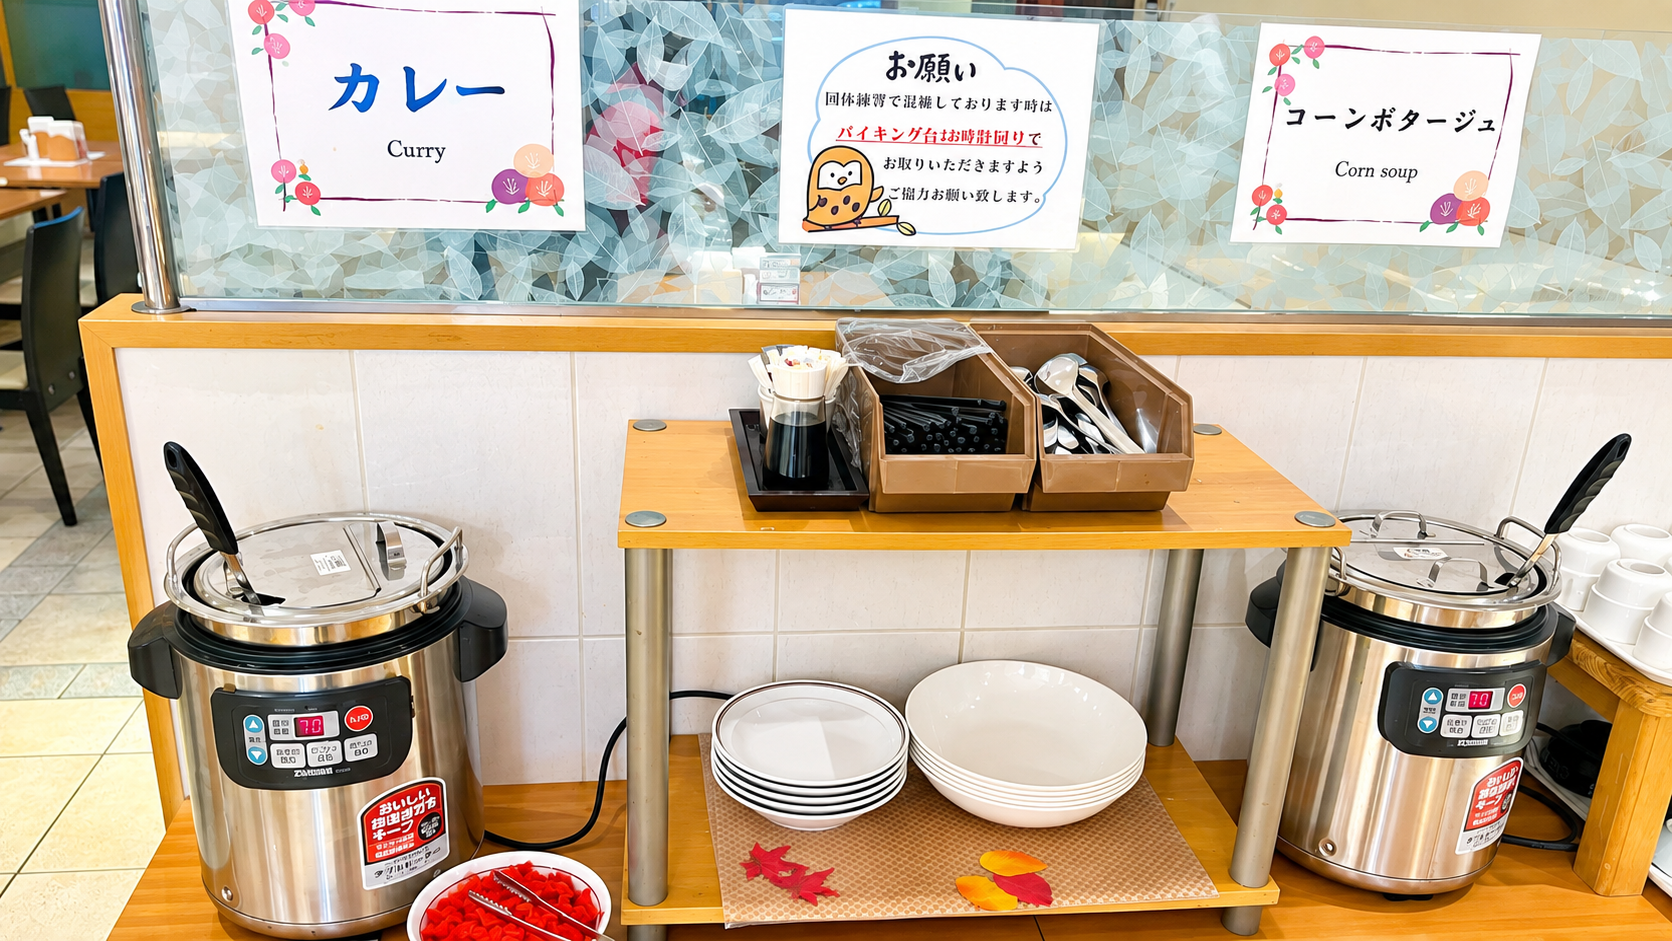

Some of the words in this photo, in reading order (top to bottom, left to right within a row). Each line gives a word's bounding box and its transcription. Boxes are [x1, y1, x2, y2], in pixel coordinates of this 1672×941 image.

[886, 50, 976, 83] お願い
[328, 63, 506, 113] カレー
[387, 139, 446, 163] Curry
[883, 156, 1043, 175] お取りいただきますよう
[1335, 161, 1375, 178] Corn
[1381, 165, 1418, 183] soup
[1471, 693, 1490, 707] 70
[299, 718, 322, 734] 70
